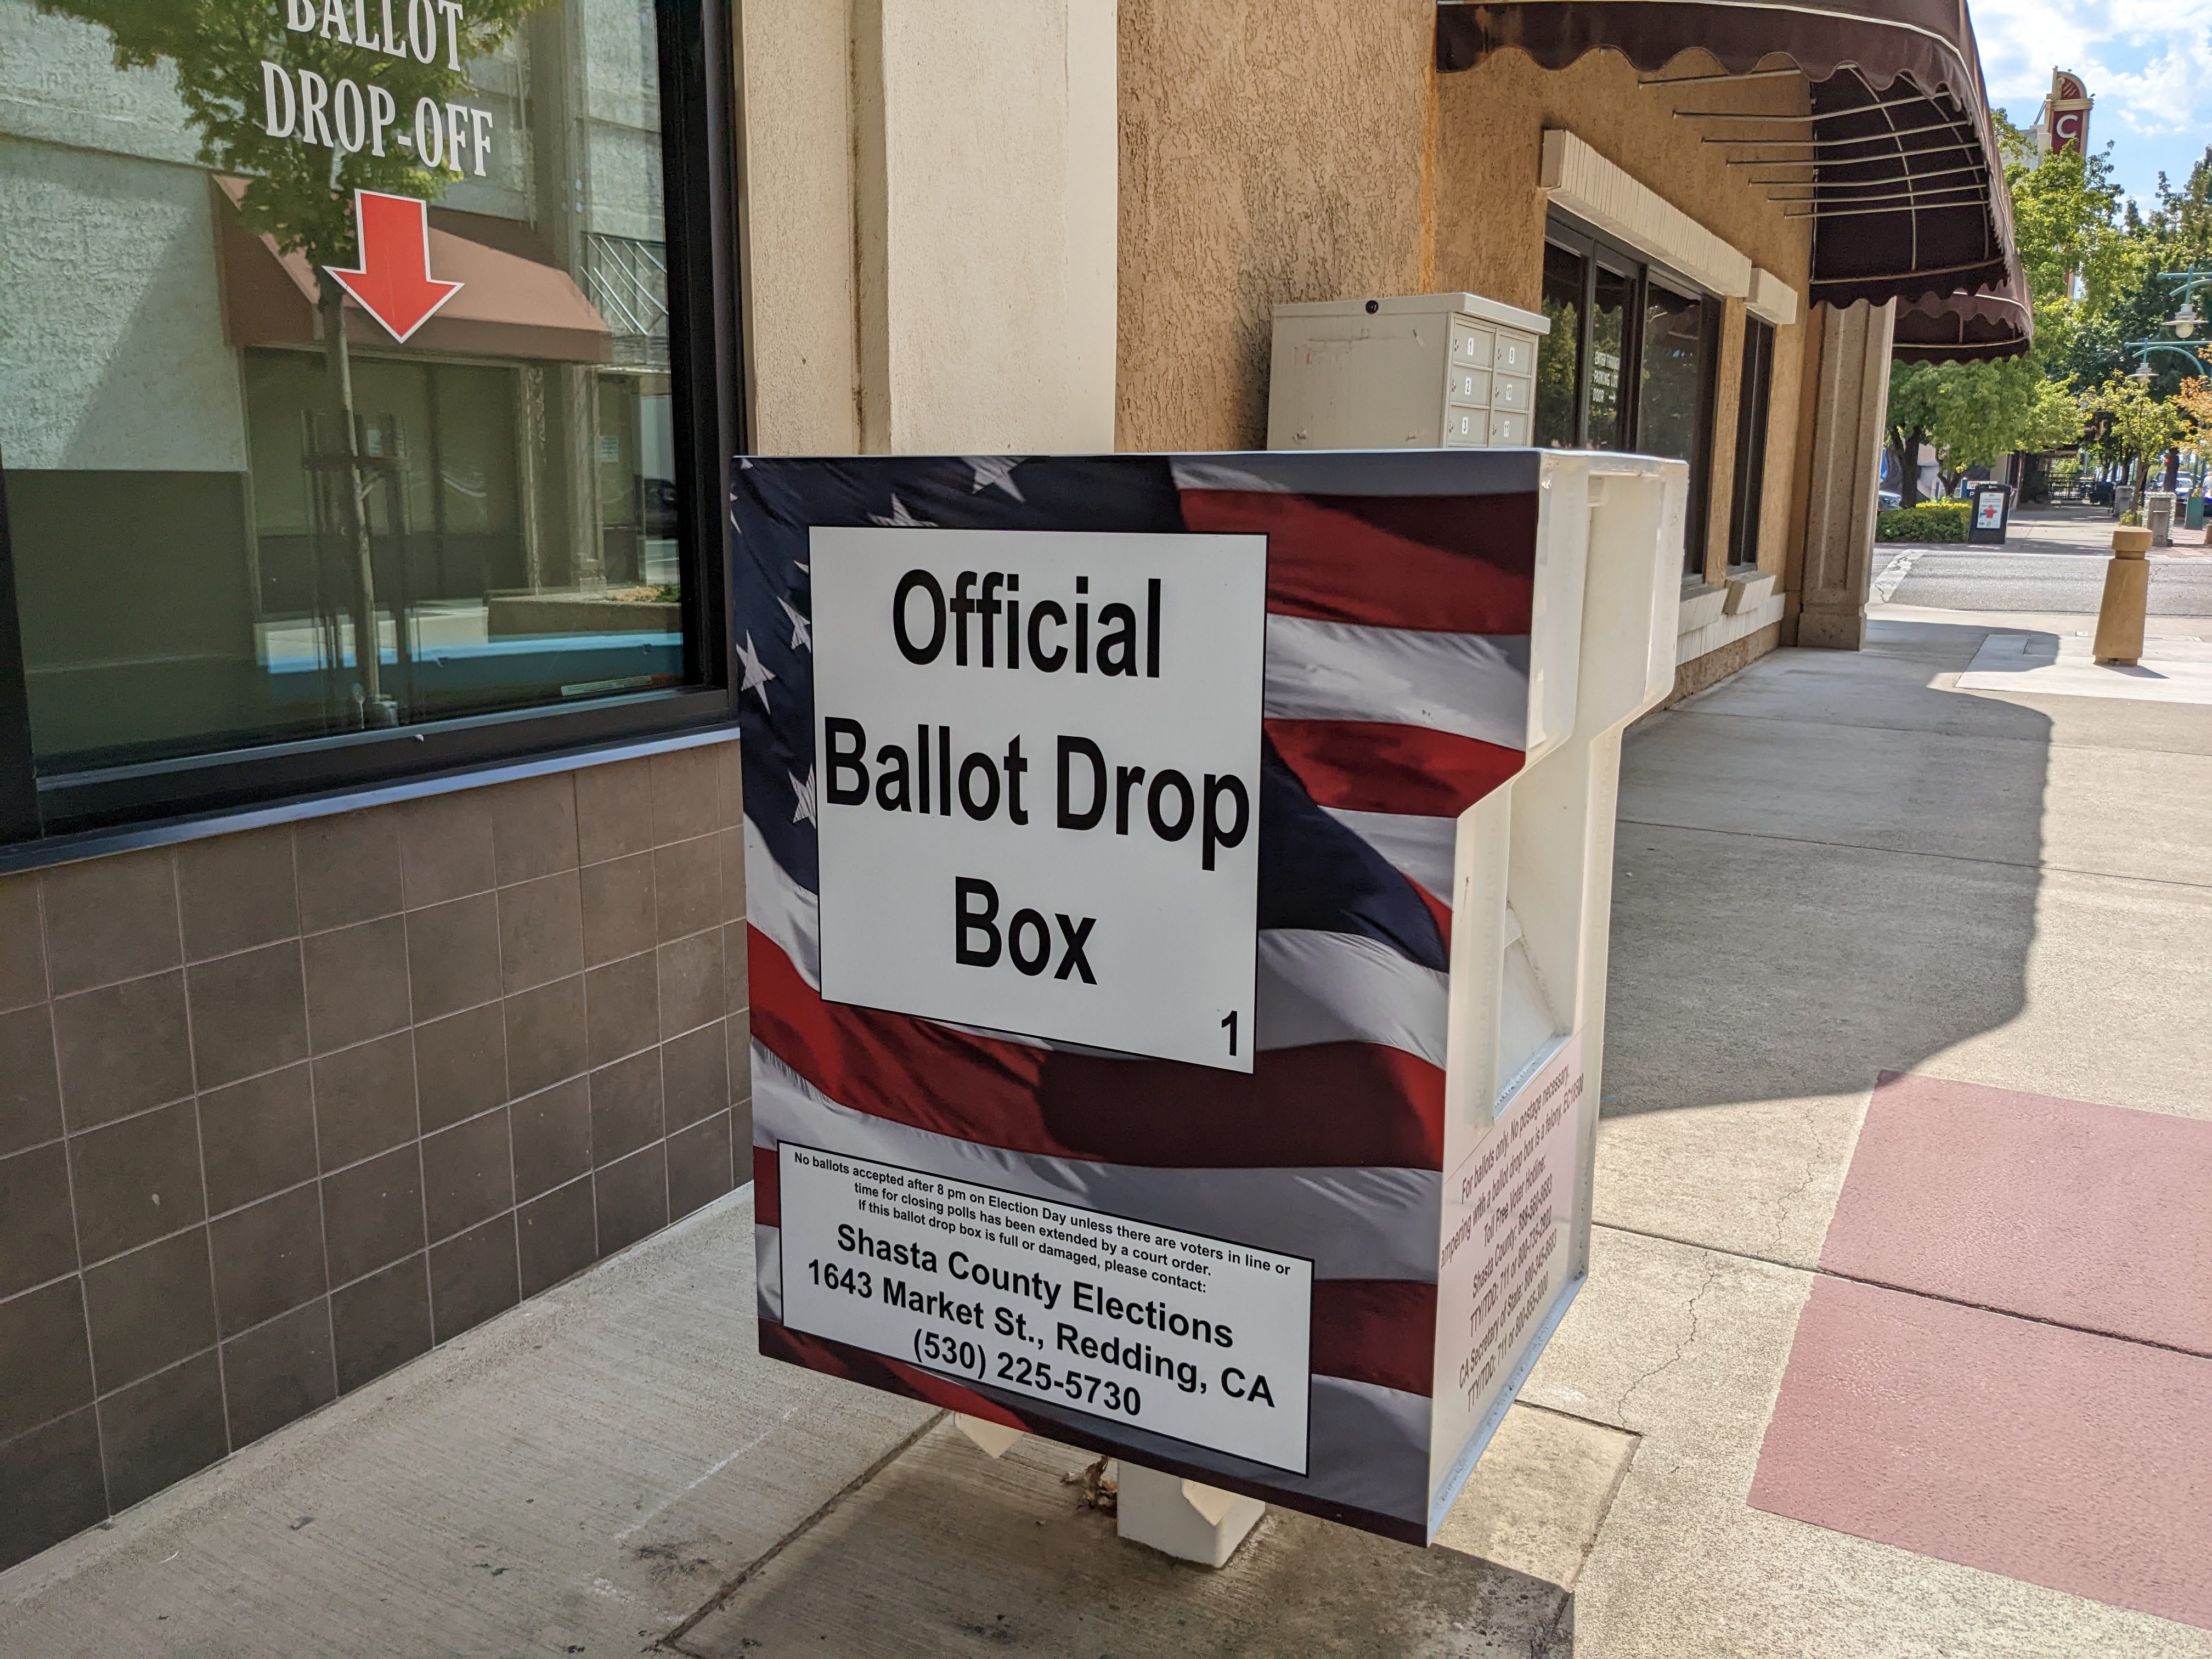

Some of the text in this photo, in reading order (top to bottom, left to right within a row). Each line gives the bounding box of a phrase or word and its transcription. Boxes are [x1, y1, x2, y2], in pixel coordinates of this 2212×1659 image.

[261, 60, 493, 177] DROP-OFF
[893, 569, 1161, 678] Official
[825, 716, 1250, 872] Ballot Drop
[955, 876, 1098, 985] Box
[1221, 1010, 1238, 1057] 1
[1441, 1215, 1471, 1267] ampering
[1473, 1193, 1485, 1227] with
[1487, 1190, 1491, 1209] a
[1492, 1163, 1508, 1201] ballot
[1510, 1150, 1522, 1179] drop
[1524, 1136, 1534, 1161] box
[1535, 1126, 1539, 1148] is
[1541, 1124, 1544, 1140] a
[1545, 1104, 1561, 1135] felony.
[1462, 1064, 1568, 1204] For ballots only. No postage necessary.
[794, 1152, 1291, 1276] No ballots accepted after 8 pm on Election Day unless there are voters in line or
[854, 1182, 1211, 1276] time for closing polls has been extended by a court order.
[859, 1199, 1206, 1293] If this ballot drop box is full or damaged, please contact:
[1485, 1154, 1545, 1247] Toll Free Voter Hotline:
[837, 1223, 1233, 1348] Shasta County Elections
[1470, 1282, 1498, 1337] TTY/TDD:
[1500, 1263, 1509, 1294] 711
[1511, 1257, 1517, 1278] or
[1473, 1257, 1493, 1299] Shasta
[1495, 1224, 1516, 1267] County:
[808, 1259, 1276, 1408] 1643 Market St., Redding, CA
[913, 1328, 1141, 1416] (530) 225-5730
[1460, 1358, 1469, 1389] CA
[1471, 1317, 1499, 1373] Secretary
[1500, 1300, 1506, 1327] of
[1508, 1282, 1523, 1317] State:
[1468, 1355, 1496, 1412] TTY/TDD:
[1498, 1334, 1506, 1365] 711
[1509, 1327, 1514, 1348] or
